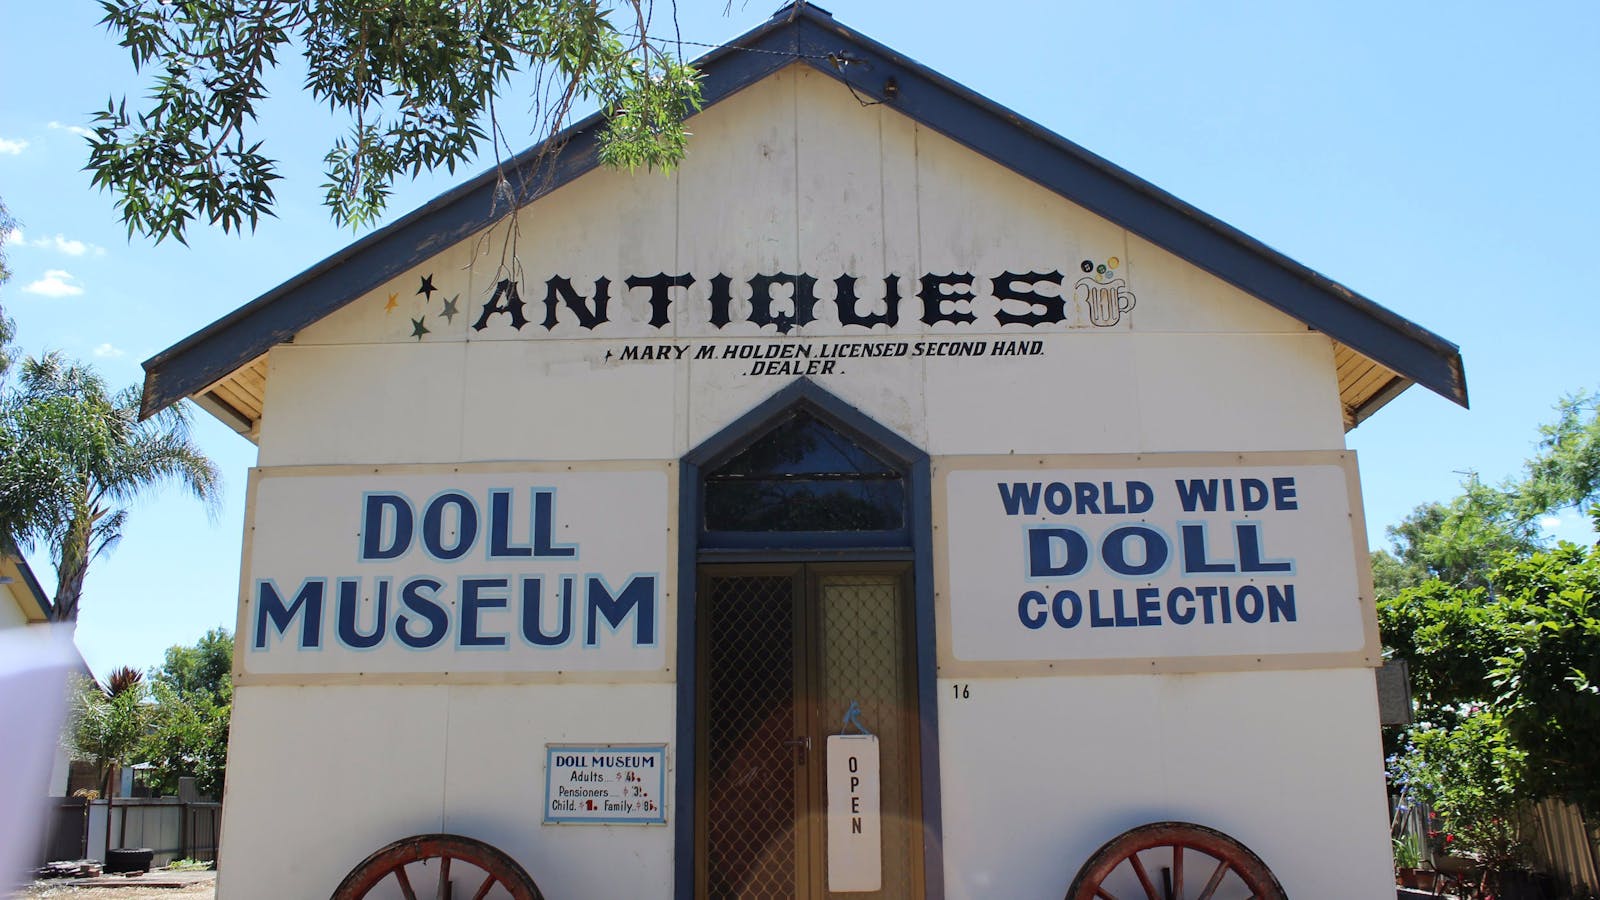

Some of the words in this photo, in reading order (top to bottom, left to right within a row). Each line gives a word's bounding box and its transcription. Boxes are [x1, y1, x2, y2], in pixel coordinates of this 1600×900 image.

[472, 271, 1067, 335] ANTIQUES
[619, 345, 690, 360] MARY
[912, 342, 987, 356] SECOND
[997, 480, 1154, 515] WORLD
[1174, 477, 1298, 512] WIDE
[358, 486, 579, 562] DOLL
[1022, 519, 1296, 583] DOLL
[251, 573, 660, 652] MUSEUM
[1017, 585, 1297, 630] COLLECTION
[953, 684, 970, 699] 16
[556, 756, 588, 768] DOLL
[592, 756, 655, 768] MUSEUM
[849, 757, 862, 834] OPEN
